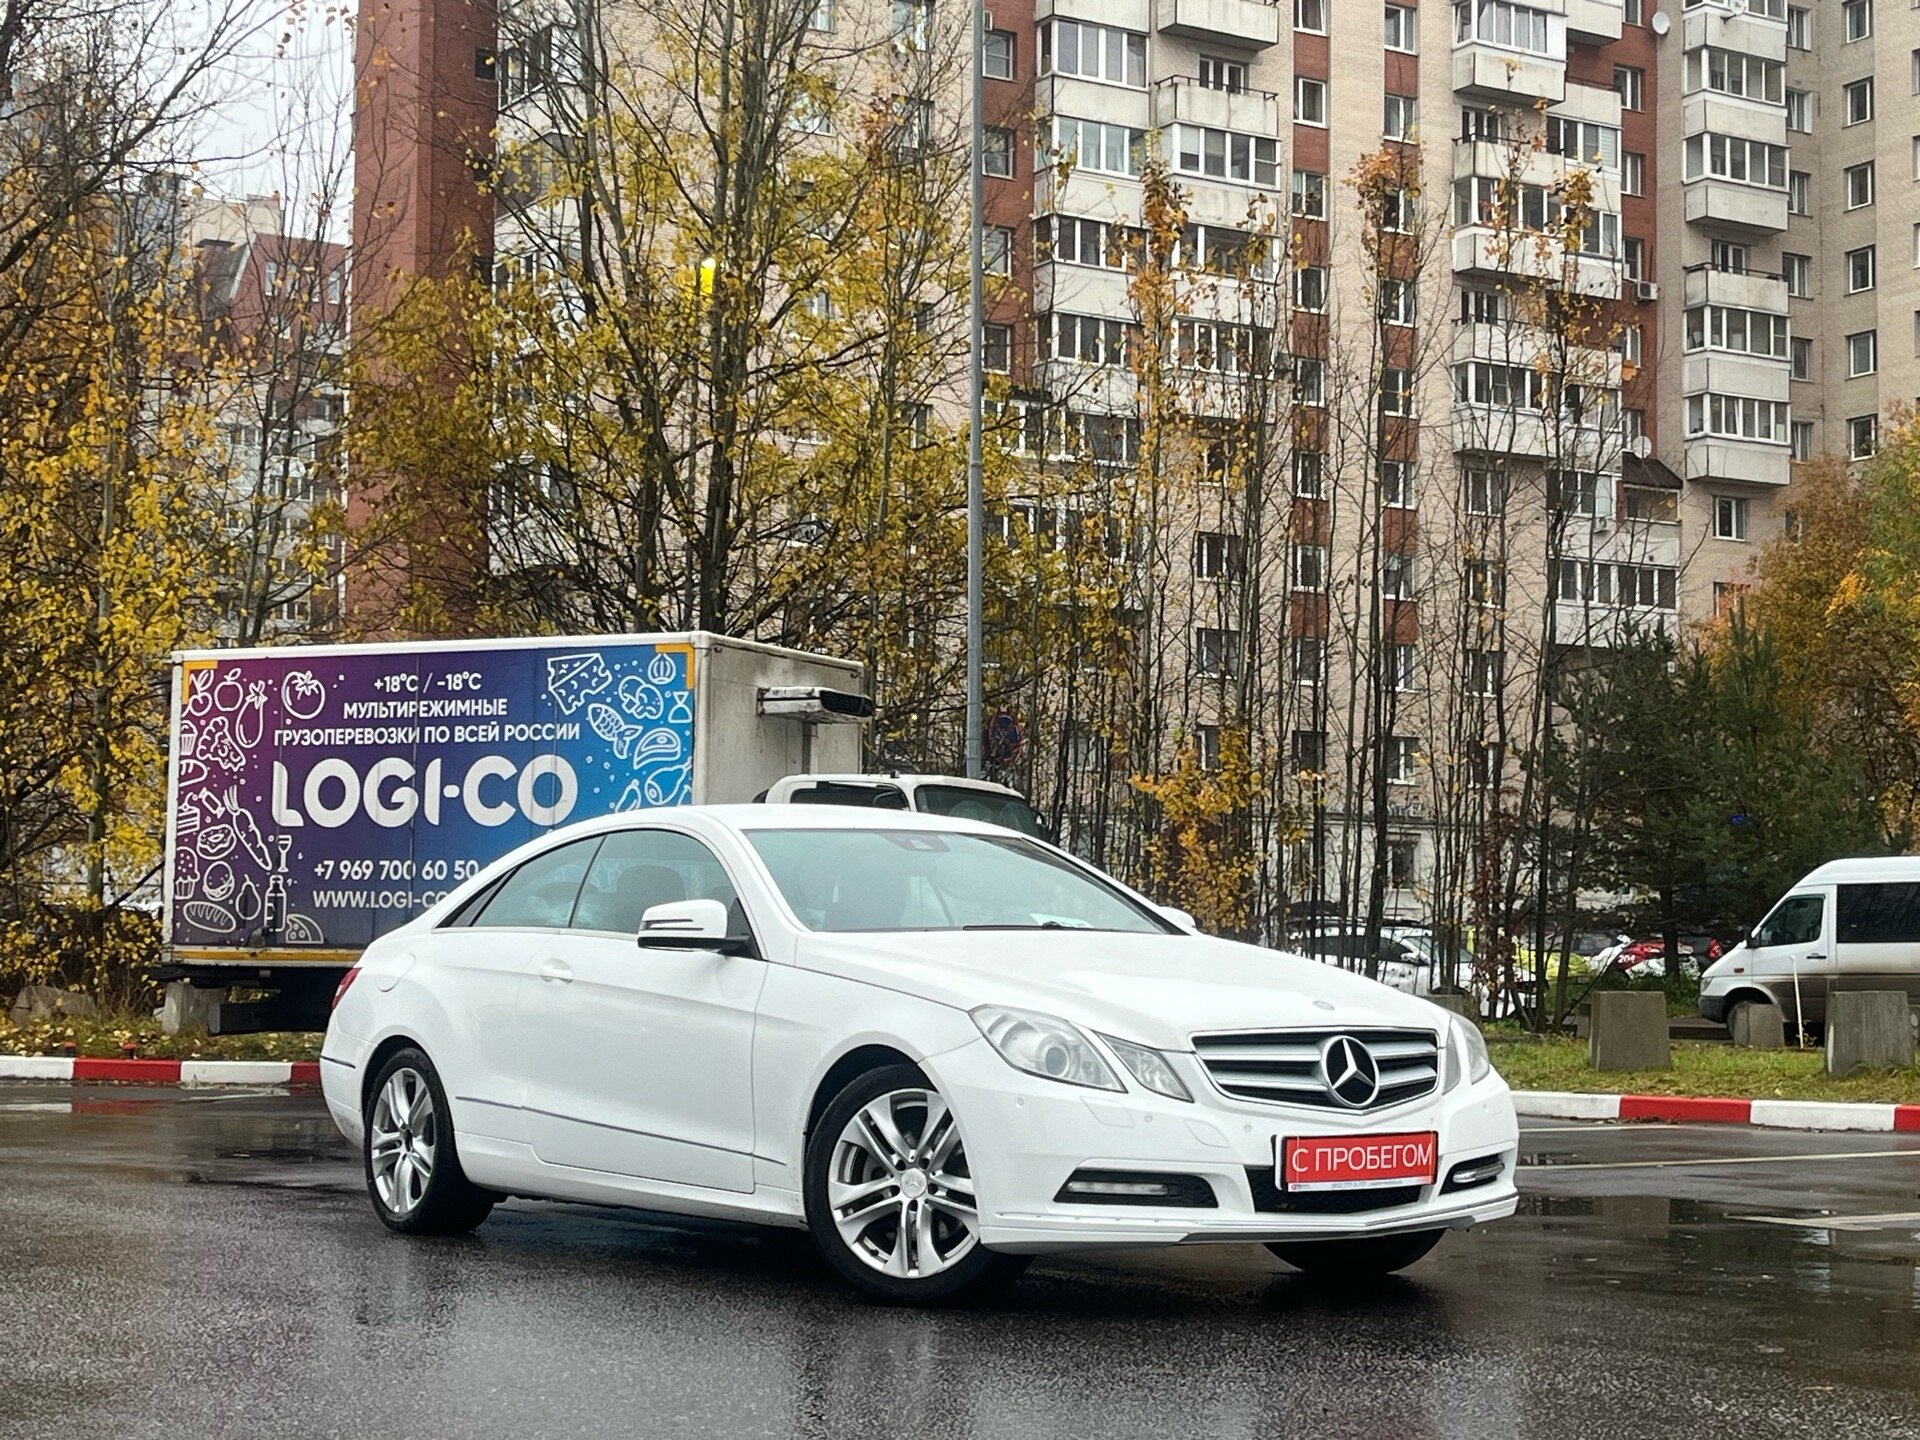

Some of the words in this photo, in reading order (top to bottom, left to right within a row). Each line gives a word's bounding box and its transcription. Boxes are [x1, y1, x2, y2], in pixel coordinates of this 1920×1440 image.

[343, 698, 508, 719] МУЛЬТИРЕЖИМНЫЕ
[274, 726, 420, 746] ГРУЗОПЕРЕВОЗКИ
[424, 726, 450, 744] ПО
[454, 721, 501, 743] ВСЕЙ
[504, 723, 580, 742] РОССИИ
[314, 860, 335, 880] +7
[339, 860, 374, 880] 969
[378, 860, 416, 880] 700
[421, 860, 448, 880] 60
[453, 860, 479, 880] 50
[1292, 1148, 1309, 1173] С
[1315, 1143, 1432, 1172] ПРОБЕГОМ
